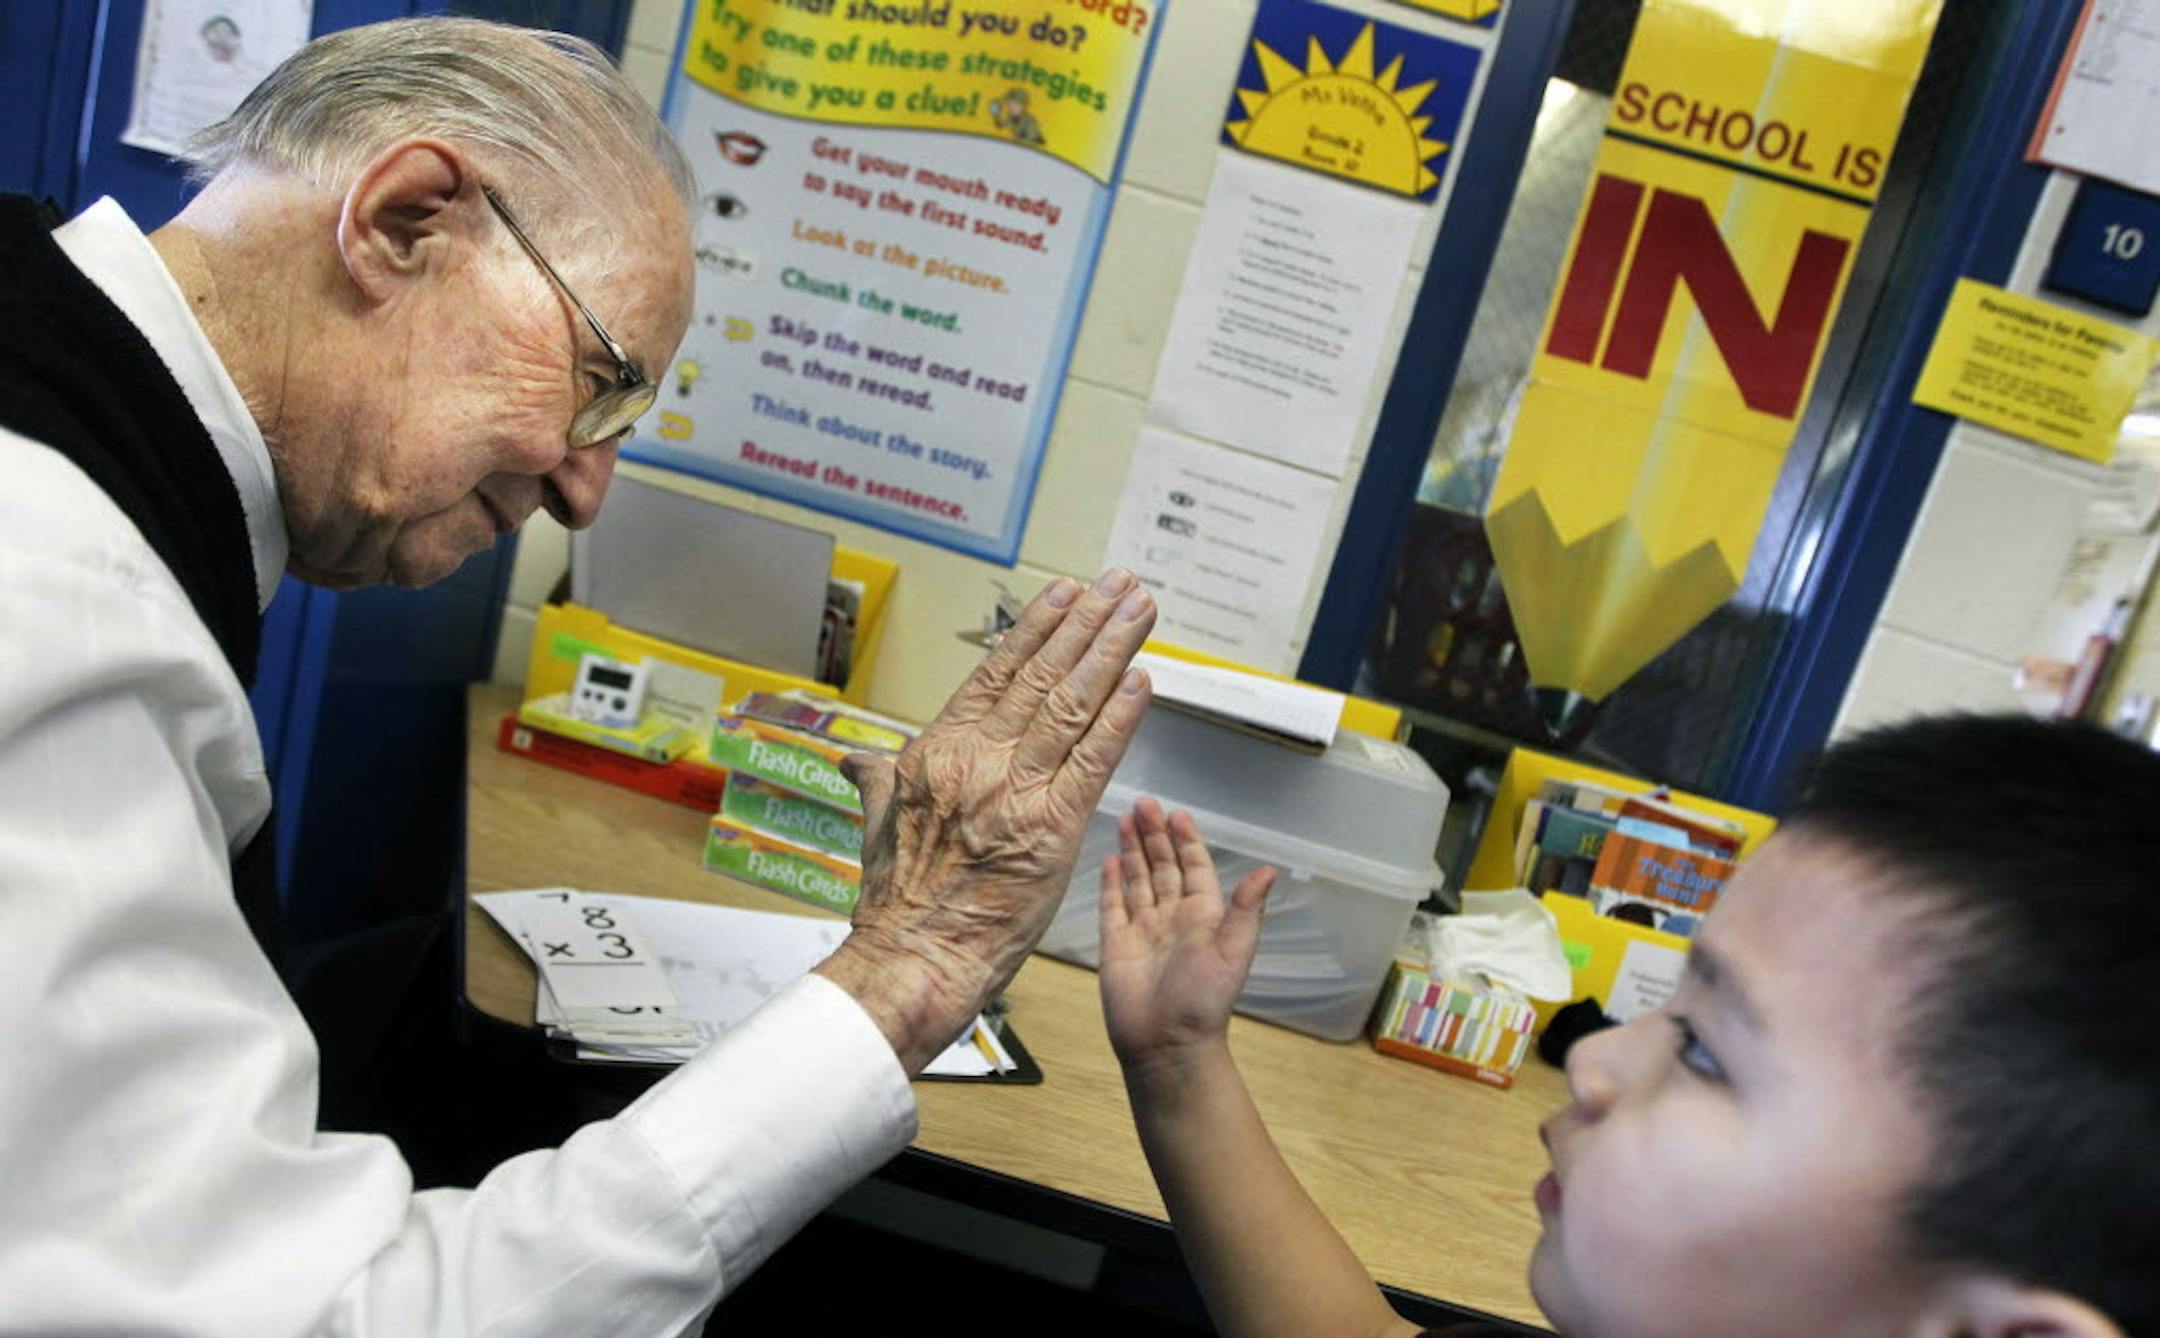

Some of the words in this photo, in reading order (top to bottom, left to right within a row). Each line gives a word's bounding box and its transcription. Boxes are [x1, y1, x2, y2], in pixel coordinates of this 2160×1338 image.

[846, 0, 951, 27] should
[958, 12, 1020, 38] you
[1029, 14, 1087, 52] do?
[1066, 0, 1148, 34] ord?
[701, 39, 728, 73] to
[736, 60, 799, 98] give
[807, 82, 866, 111] you
[875, 90, 896, 111] a
[905, 83, 981, 118] clue!
[712, 0, 753, 43] Try
[761, 27, 817, 57] one
[825, 34, 861, 63] of
[867, 36, 950, 71] these
[960, 52, 1107, 113] strategies
[1616, 82, 1814, 173] SCHOOL
[1832, 142, 1883, 189] IS
[803, 172, 828, 193] to
[832, 180, 873, 210] say
[878, 190, 915, 217] the
[920, 199, 967, 231] first
[972, 217, 1049, 254] sound.
[811, 136, 853, 165] Get
[857, 153, 911, 179] your
[914, 166, 990, 202] mouth
[995, 188, 1062, 227] ready
[791, 217, 848, 251] Look
[852, 239, 877, 258] at
[881, 243, 920, 271] the
[922, 256, 1012, 295] picture.
[2103, 224, 2143, 260] 10
[780, 266, 852, 303] Chunk
[857, 289, 895, 316] the
[900, 303, 962, 335] word.
[1545, 172, 1851, 420] IN
[760, 350, 795, 375] on,
[802, 358, 853, 388] then
[857, 376, 935, 412] reread.
[767, 314, 818, 348] Skip
[823, 331, 861, 358] the
[866, 346, 925, 374] word
[926, 363, 972, 388] and
[974, 376, 1028, 403] read
[750, 393, 811, 428] Think
[816, 414, 883, 448] about
[886, 433, 924, 459] the
[928, 446, 993, 481] story.
[739, 439, 819, 479] Reread
[823, 463, 859, 490] the
[863, 478, 970, 523] sentence.
[749, 740, 797, 779] Flash
[799, 760, 850, 796] Cards
[764, 796, 813, 834] Flash
[747, 851, 796, 888] Flash
[799, 868, 850, 902] Cards
[581, 906, 616, 929] 8
[597, 933, 634, 959] 3
